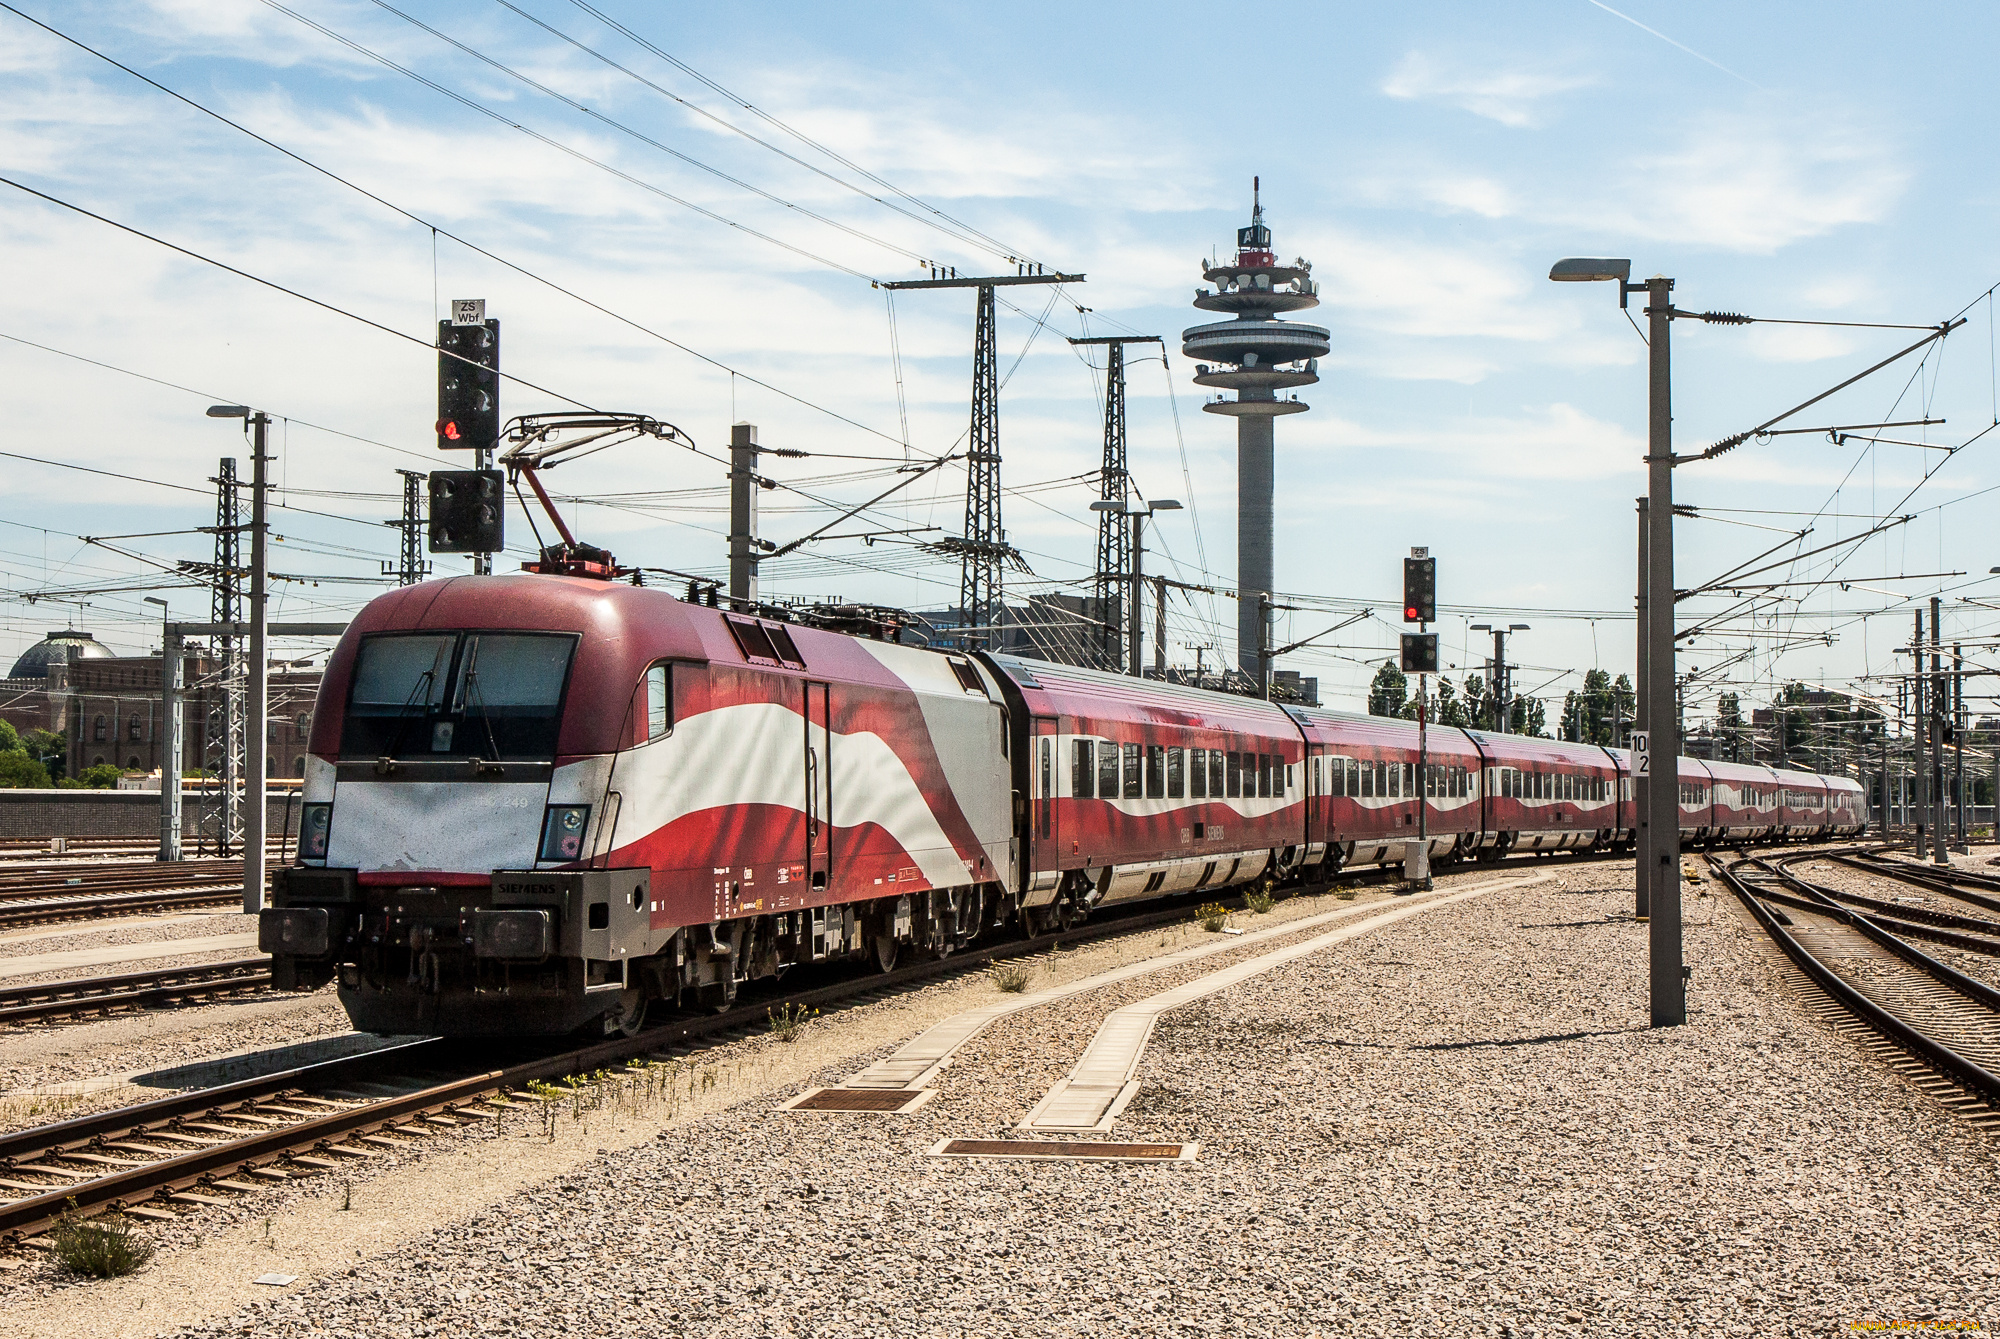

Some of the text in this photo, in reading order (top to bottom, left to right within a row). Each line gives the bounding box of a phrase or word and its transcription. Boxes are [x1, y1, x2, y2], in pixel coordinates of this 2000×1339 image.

[1243, 228, 1254, 244] A1
[461, 302, 476, 311] ZS
[458, 313, 480, 322] Wbf
[1632, 735, 1647, 752] 10
[1640, 755, 1649, 772] 2
[499, 883, 555, 894] SIEMENS
